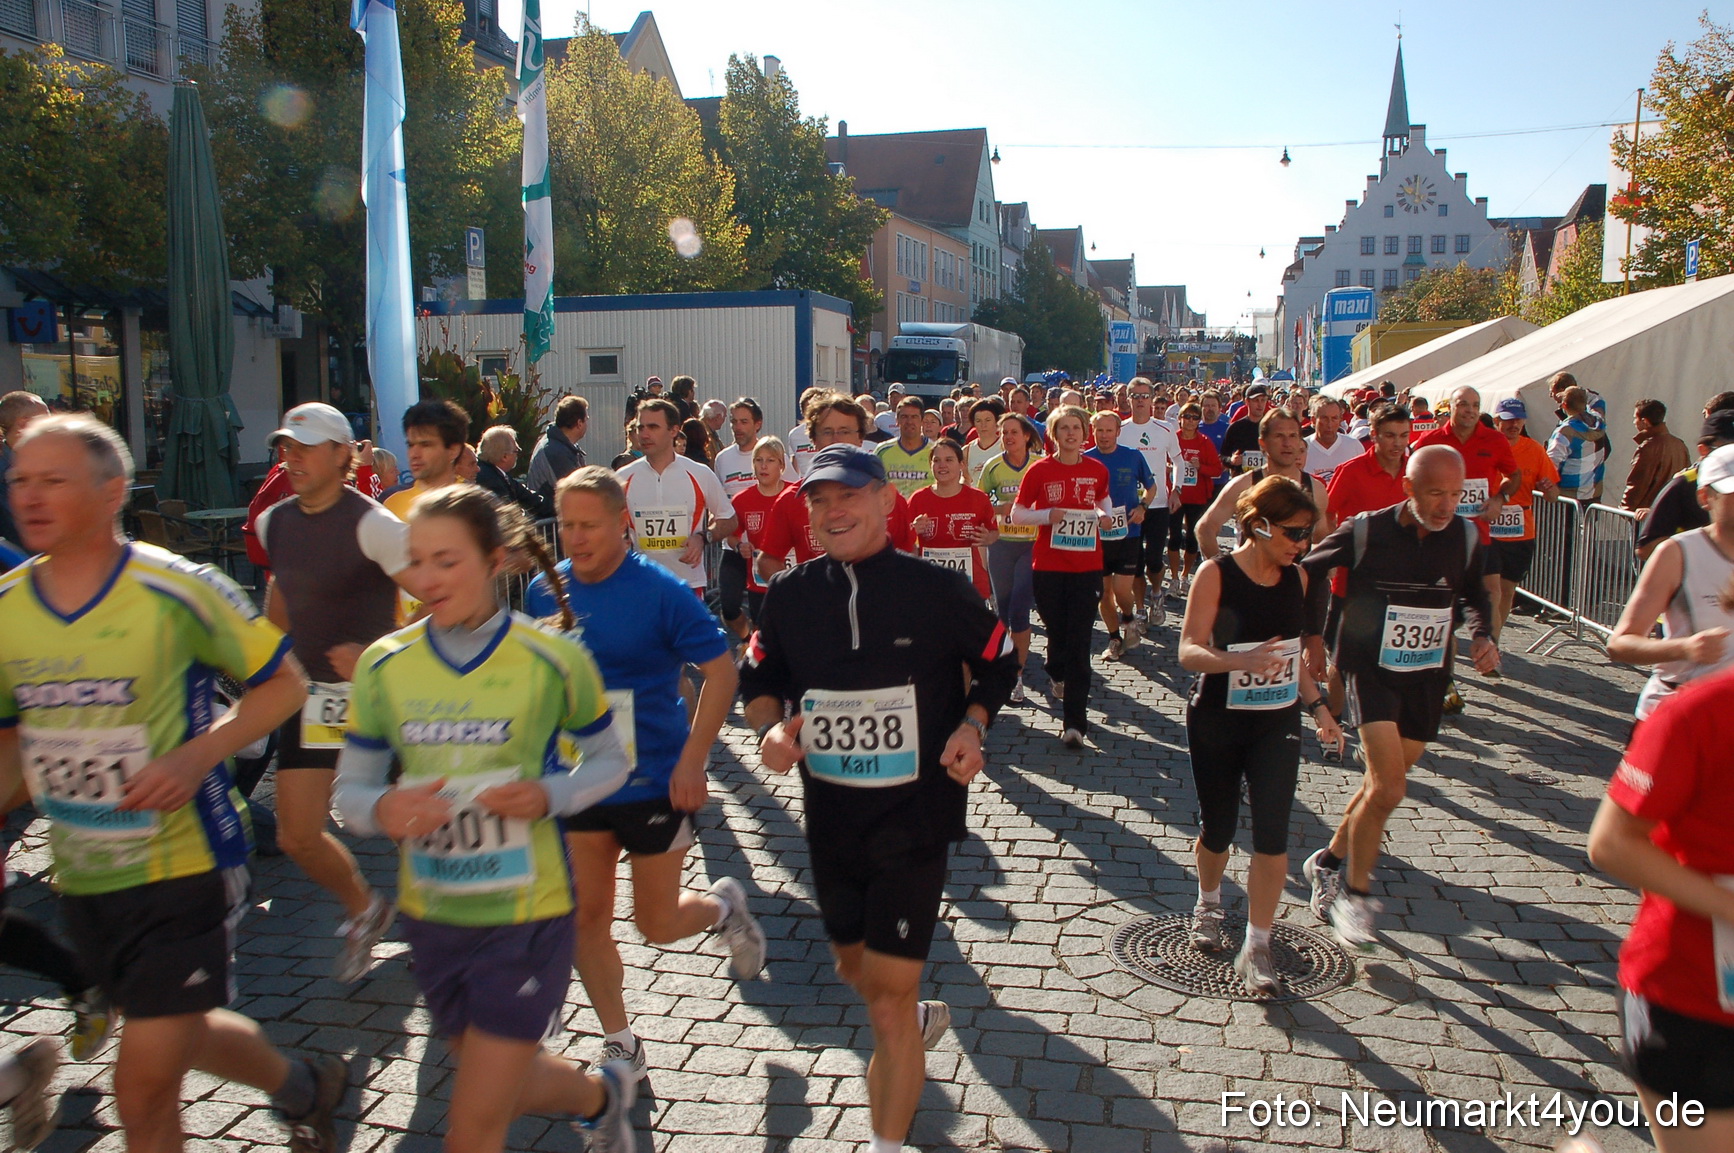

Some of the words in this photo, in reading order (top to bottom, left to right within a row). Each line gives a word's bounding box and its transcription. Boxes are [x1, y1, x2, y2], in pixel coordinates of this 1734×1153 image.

[470, 232, 480, 261] P
[1688, 245, 1697, 272] P
[1334, 295, 1370, 315] maxi
[1119, 344, 1129, 352] dsl
[1247, 457, 1264, 467] 631
[888, 471, 928, 479] BOCK
[645, 518, 677, 537] 574
[1004, 525, 1030, 534] Brigitte
[1057, 519, 1094, 536] 2137
[646, 537, 678, 549] Jürgen
[1060, 536, 1089, 547] Angela
[1391, 624, 1445, 649] 3394
[1244, 688, 1289, 702] Andrea
[813, 714, 904, 751] 3338
[841, 755, 880, 775] Karl
